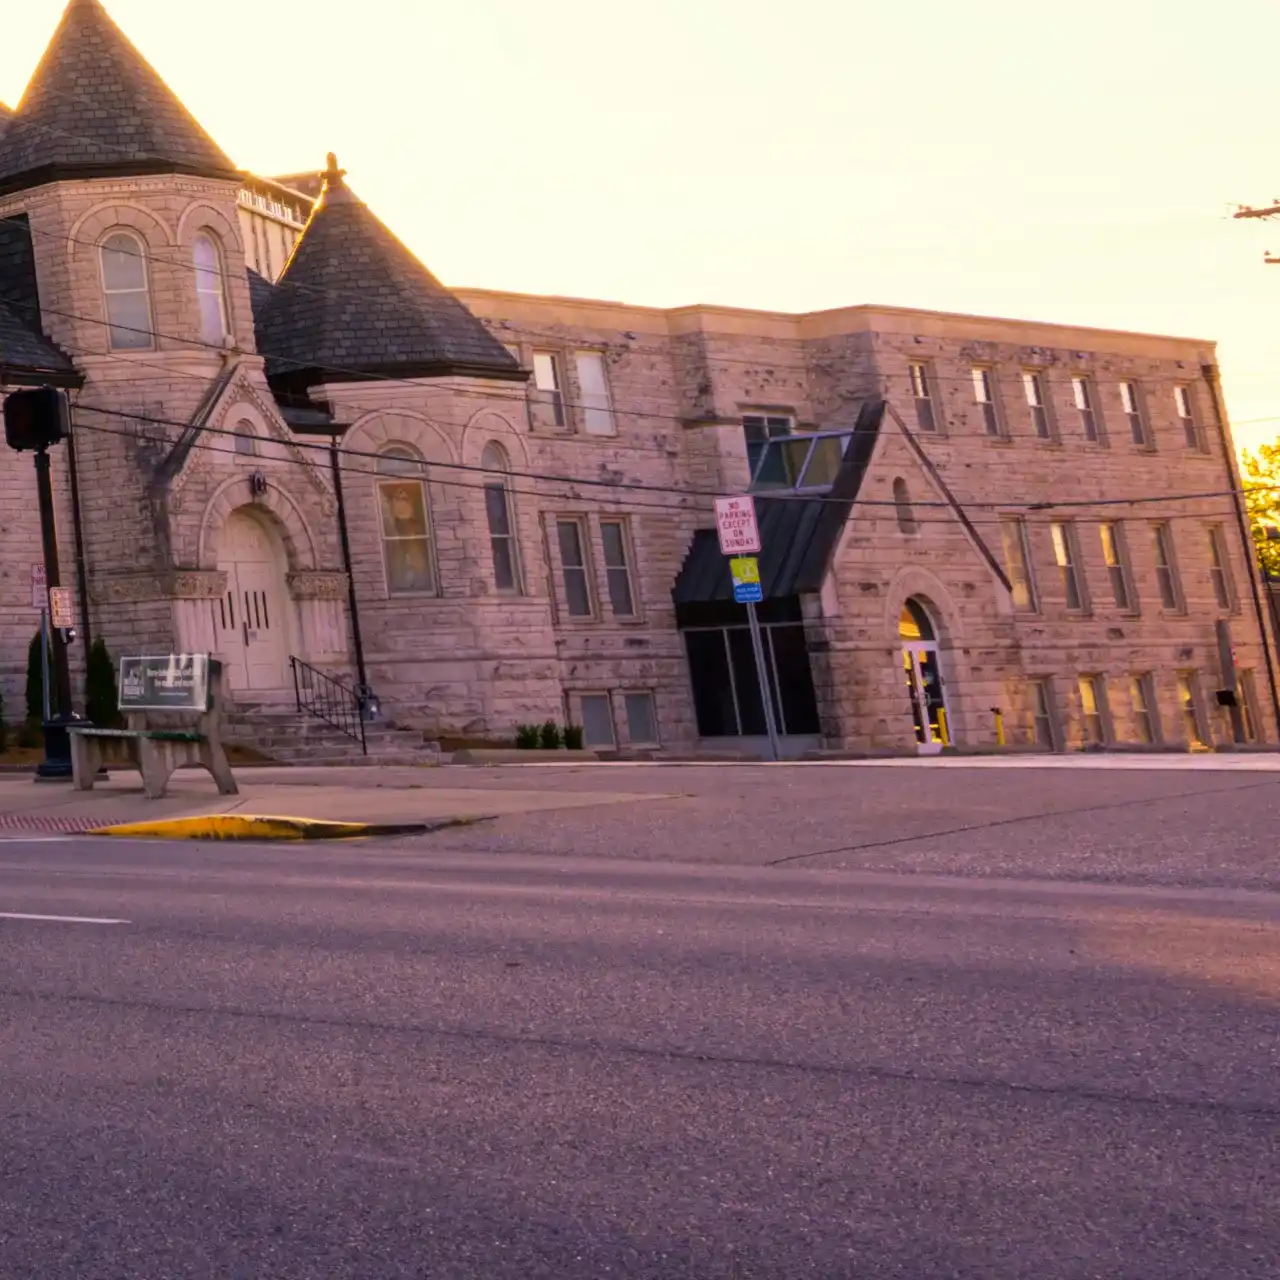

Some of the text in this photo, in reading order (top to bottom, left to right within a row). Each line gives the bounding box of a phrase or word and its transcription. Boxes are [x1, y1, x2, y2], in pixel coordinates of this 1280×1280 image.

[728, 501, 740, 511] NO
[720, 510, 752, 519] PARKING
[722, 519, 751, 529] EXCEPT
[733, 529, 744, 538] ON
[725, 538, 754, 548] SUNDAY
